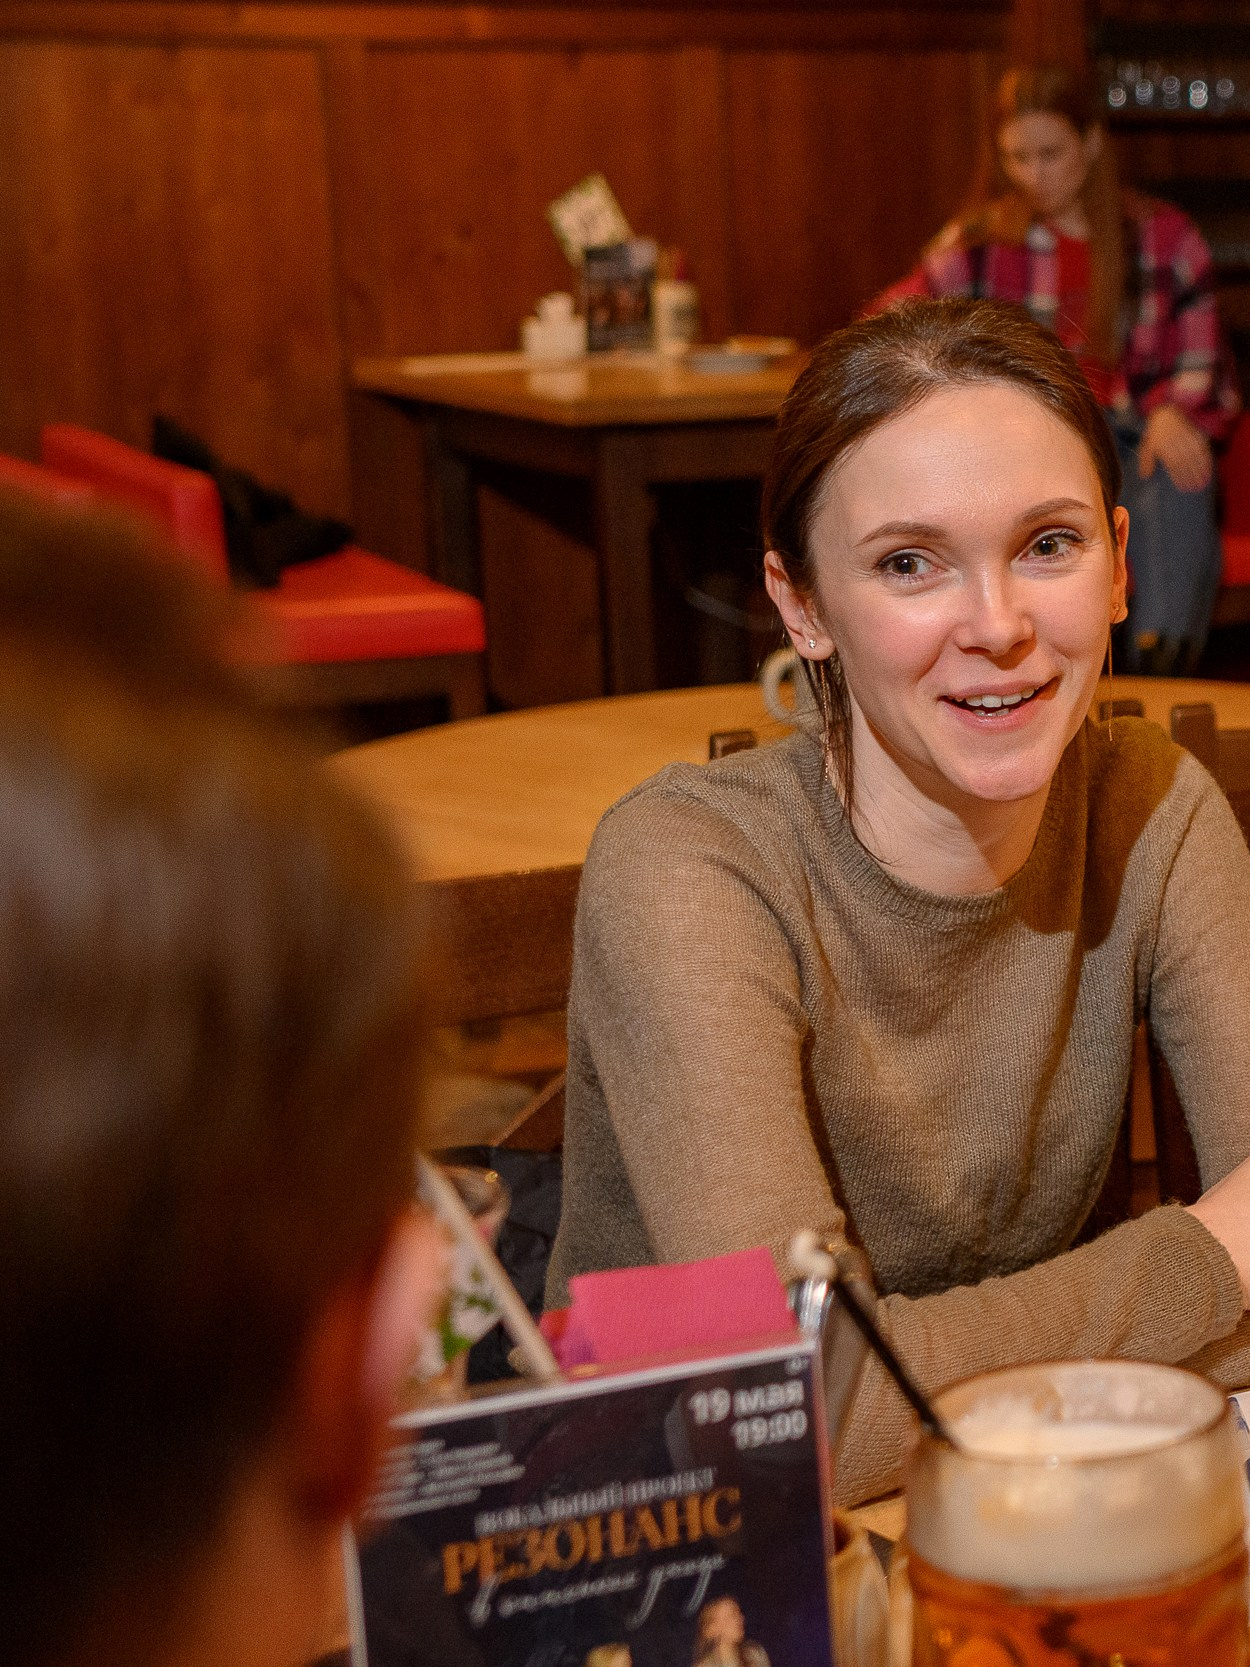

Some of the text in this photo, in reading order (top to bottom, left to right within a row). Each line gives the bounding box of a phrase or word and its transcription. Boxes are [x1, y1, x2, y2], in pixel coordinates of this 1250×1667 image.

[688, 1379, 805, 1425] 19 мая
[731, 1409, 808, 1450] 19:00
[441, 1487, 742, 1595] РЕЗОНАНС
